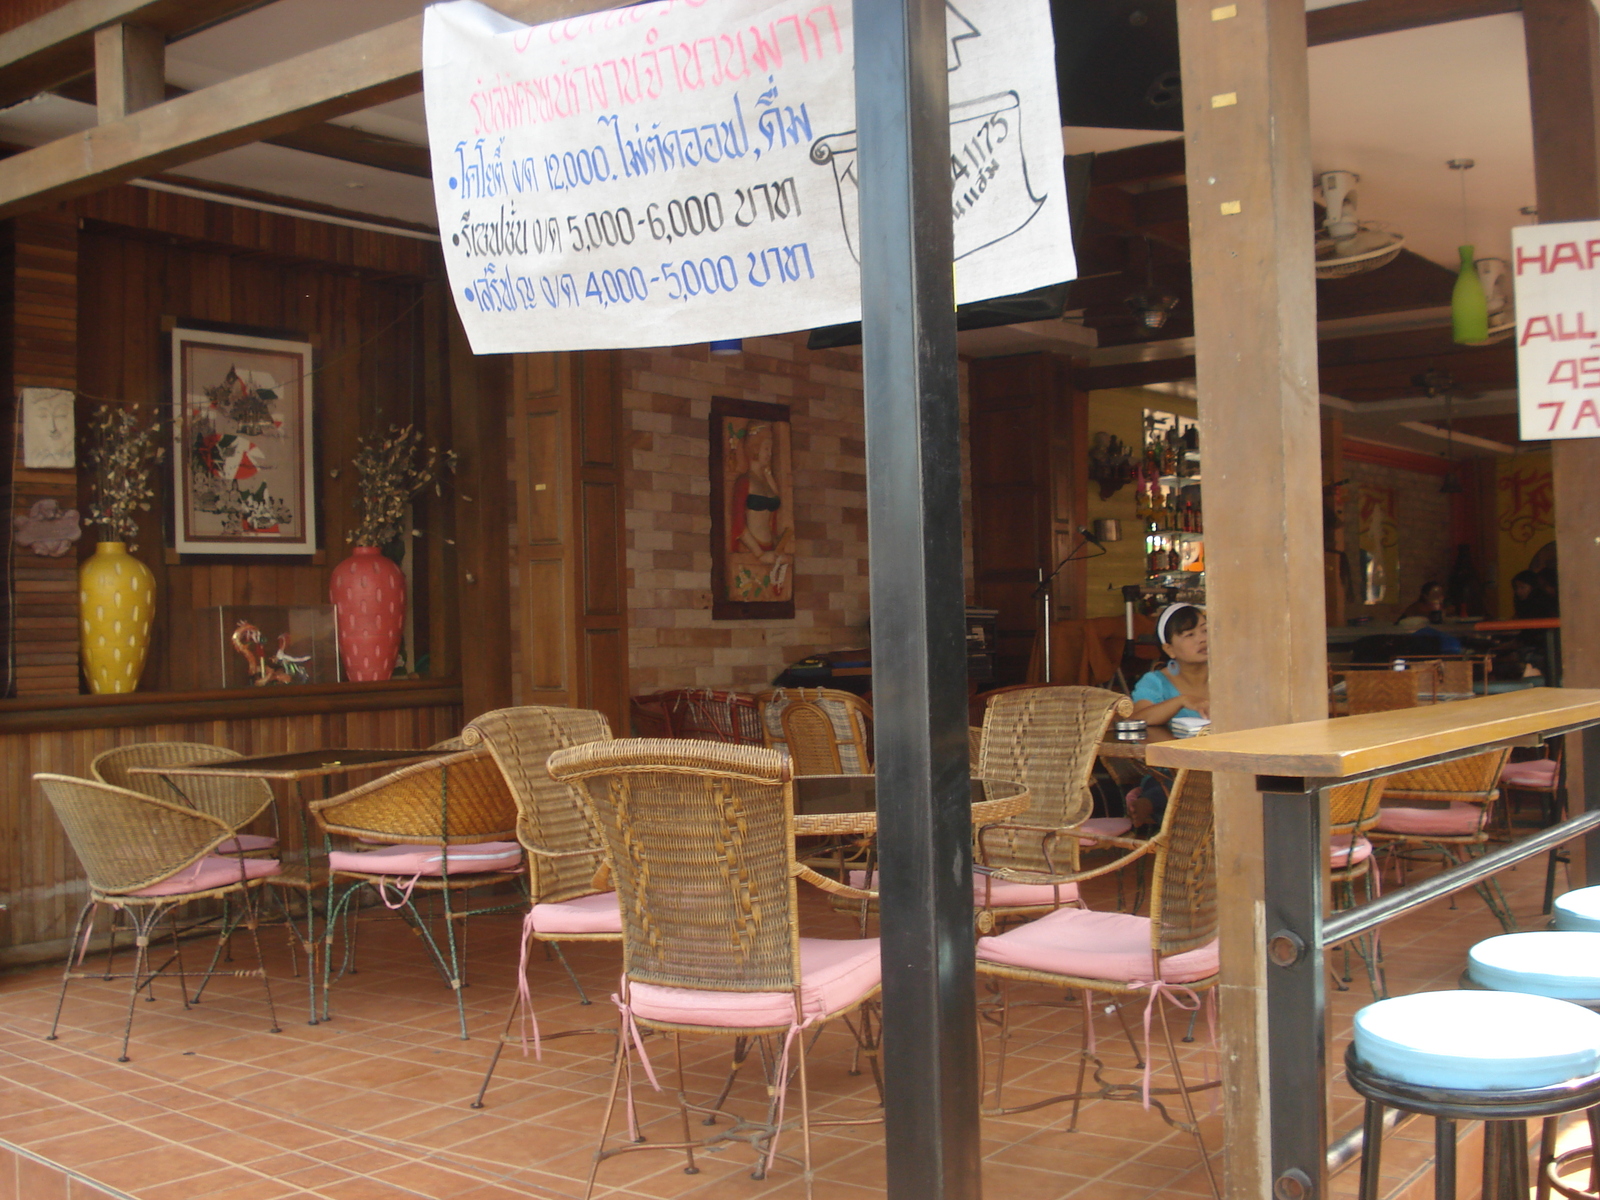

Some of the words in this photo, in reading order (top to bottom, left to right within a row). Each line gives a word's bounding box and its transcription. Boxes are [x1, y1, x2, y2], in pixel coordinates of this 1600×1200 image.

[566, 191, 724, 253] 5,000-6,000
[734, 176, 802, 228] บาท
[585, 254, 739, 309] 4,000-5,000
[747, 242, 815, 287] บาท
[1520, 311, 1597, 346] ALL
